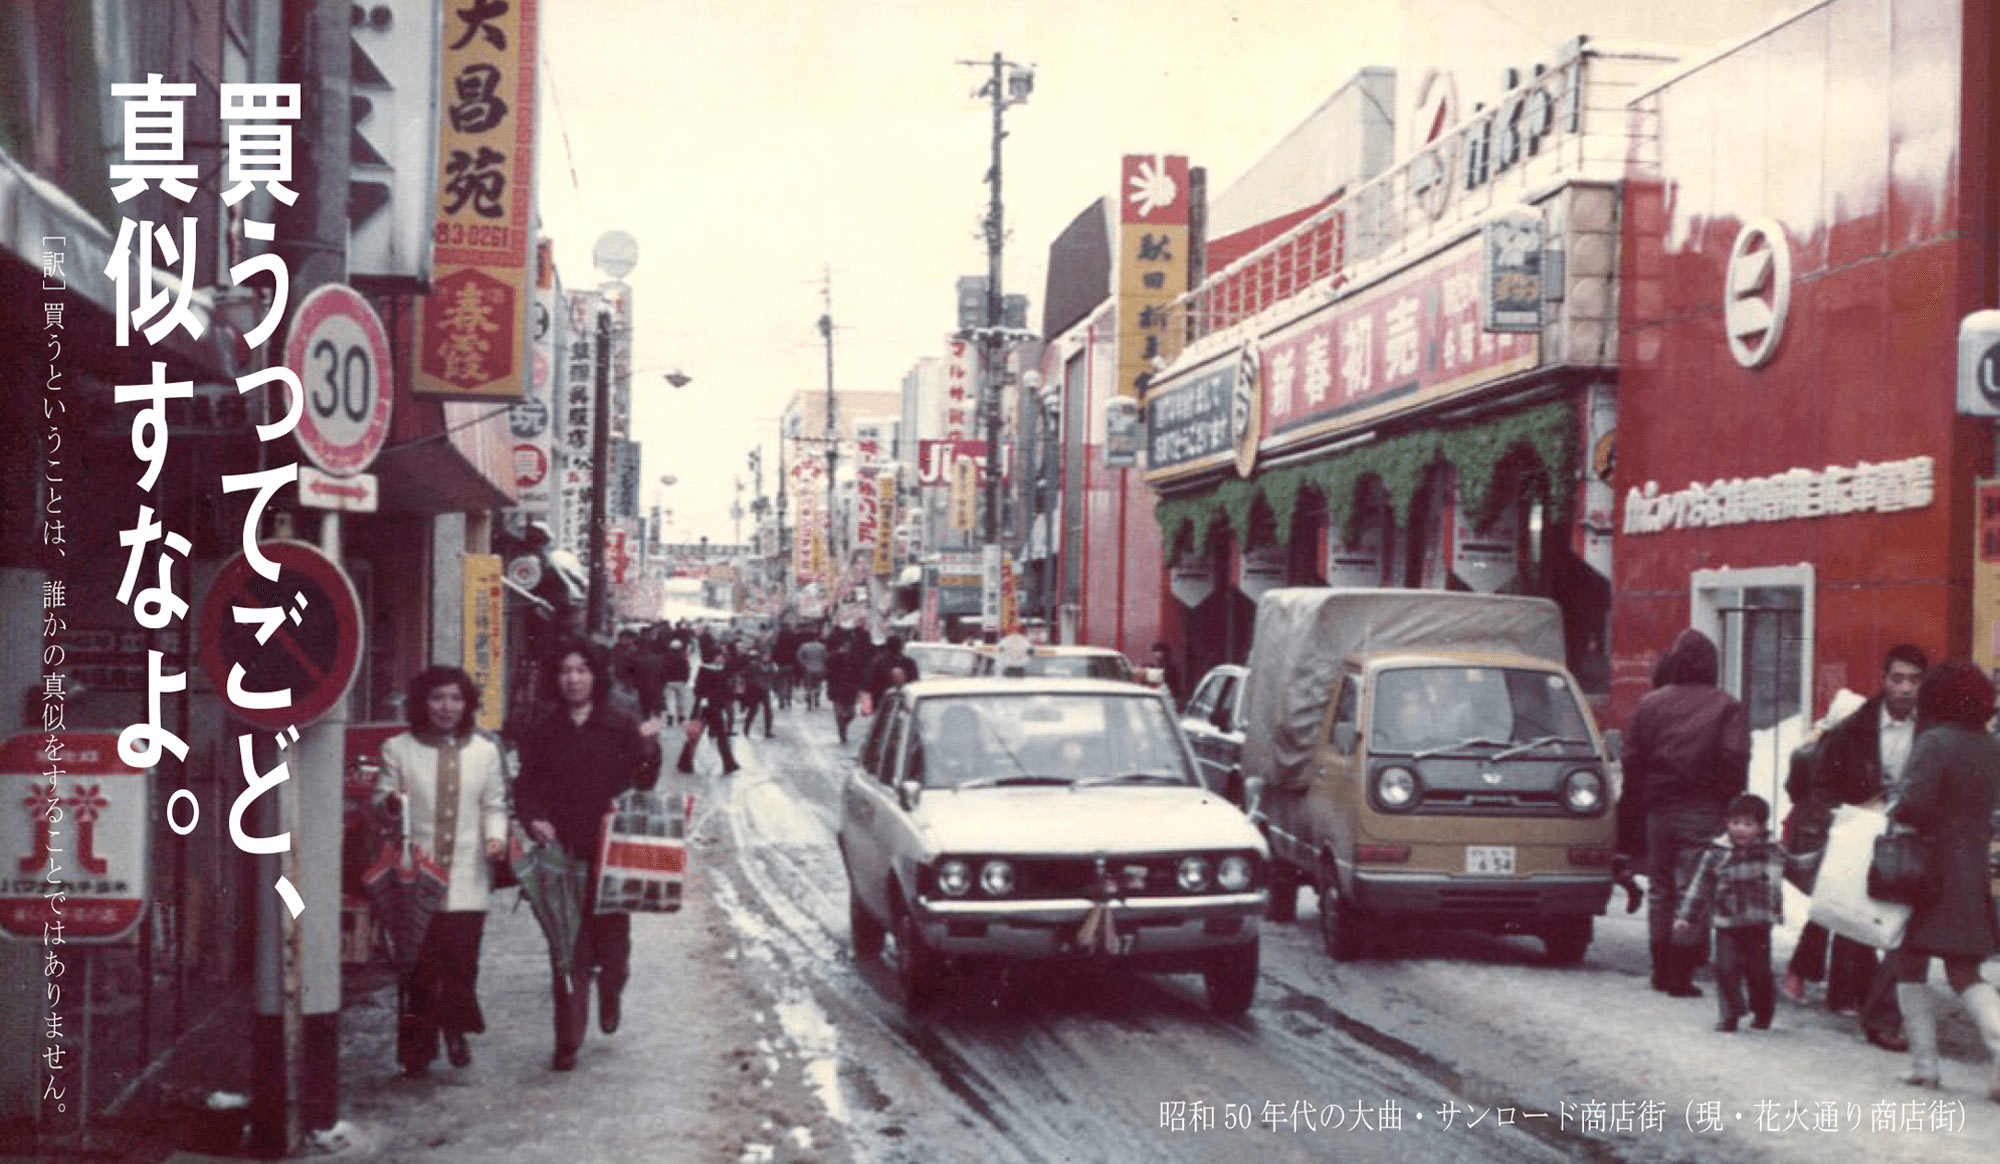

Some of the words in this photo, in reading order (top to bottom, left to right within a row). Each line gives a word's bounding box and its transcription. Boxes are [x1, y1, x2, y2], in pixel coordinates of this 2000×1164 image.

[443, 0, 509, 219] 大昌苑
[311, 339, 370, 421] 30
[1270, 297, 1421, 417] 新春初売
